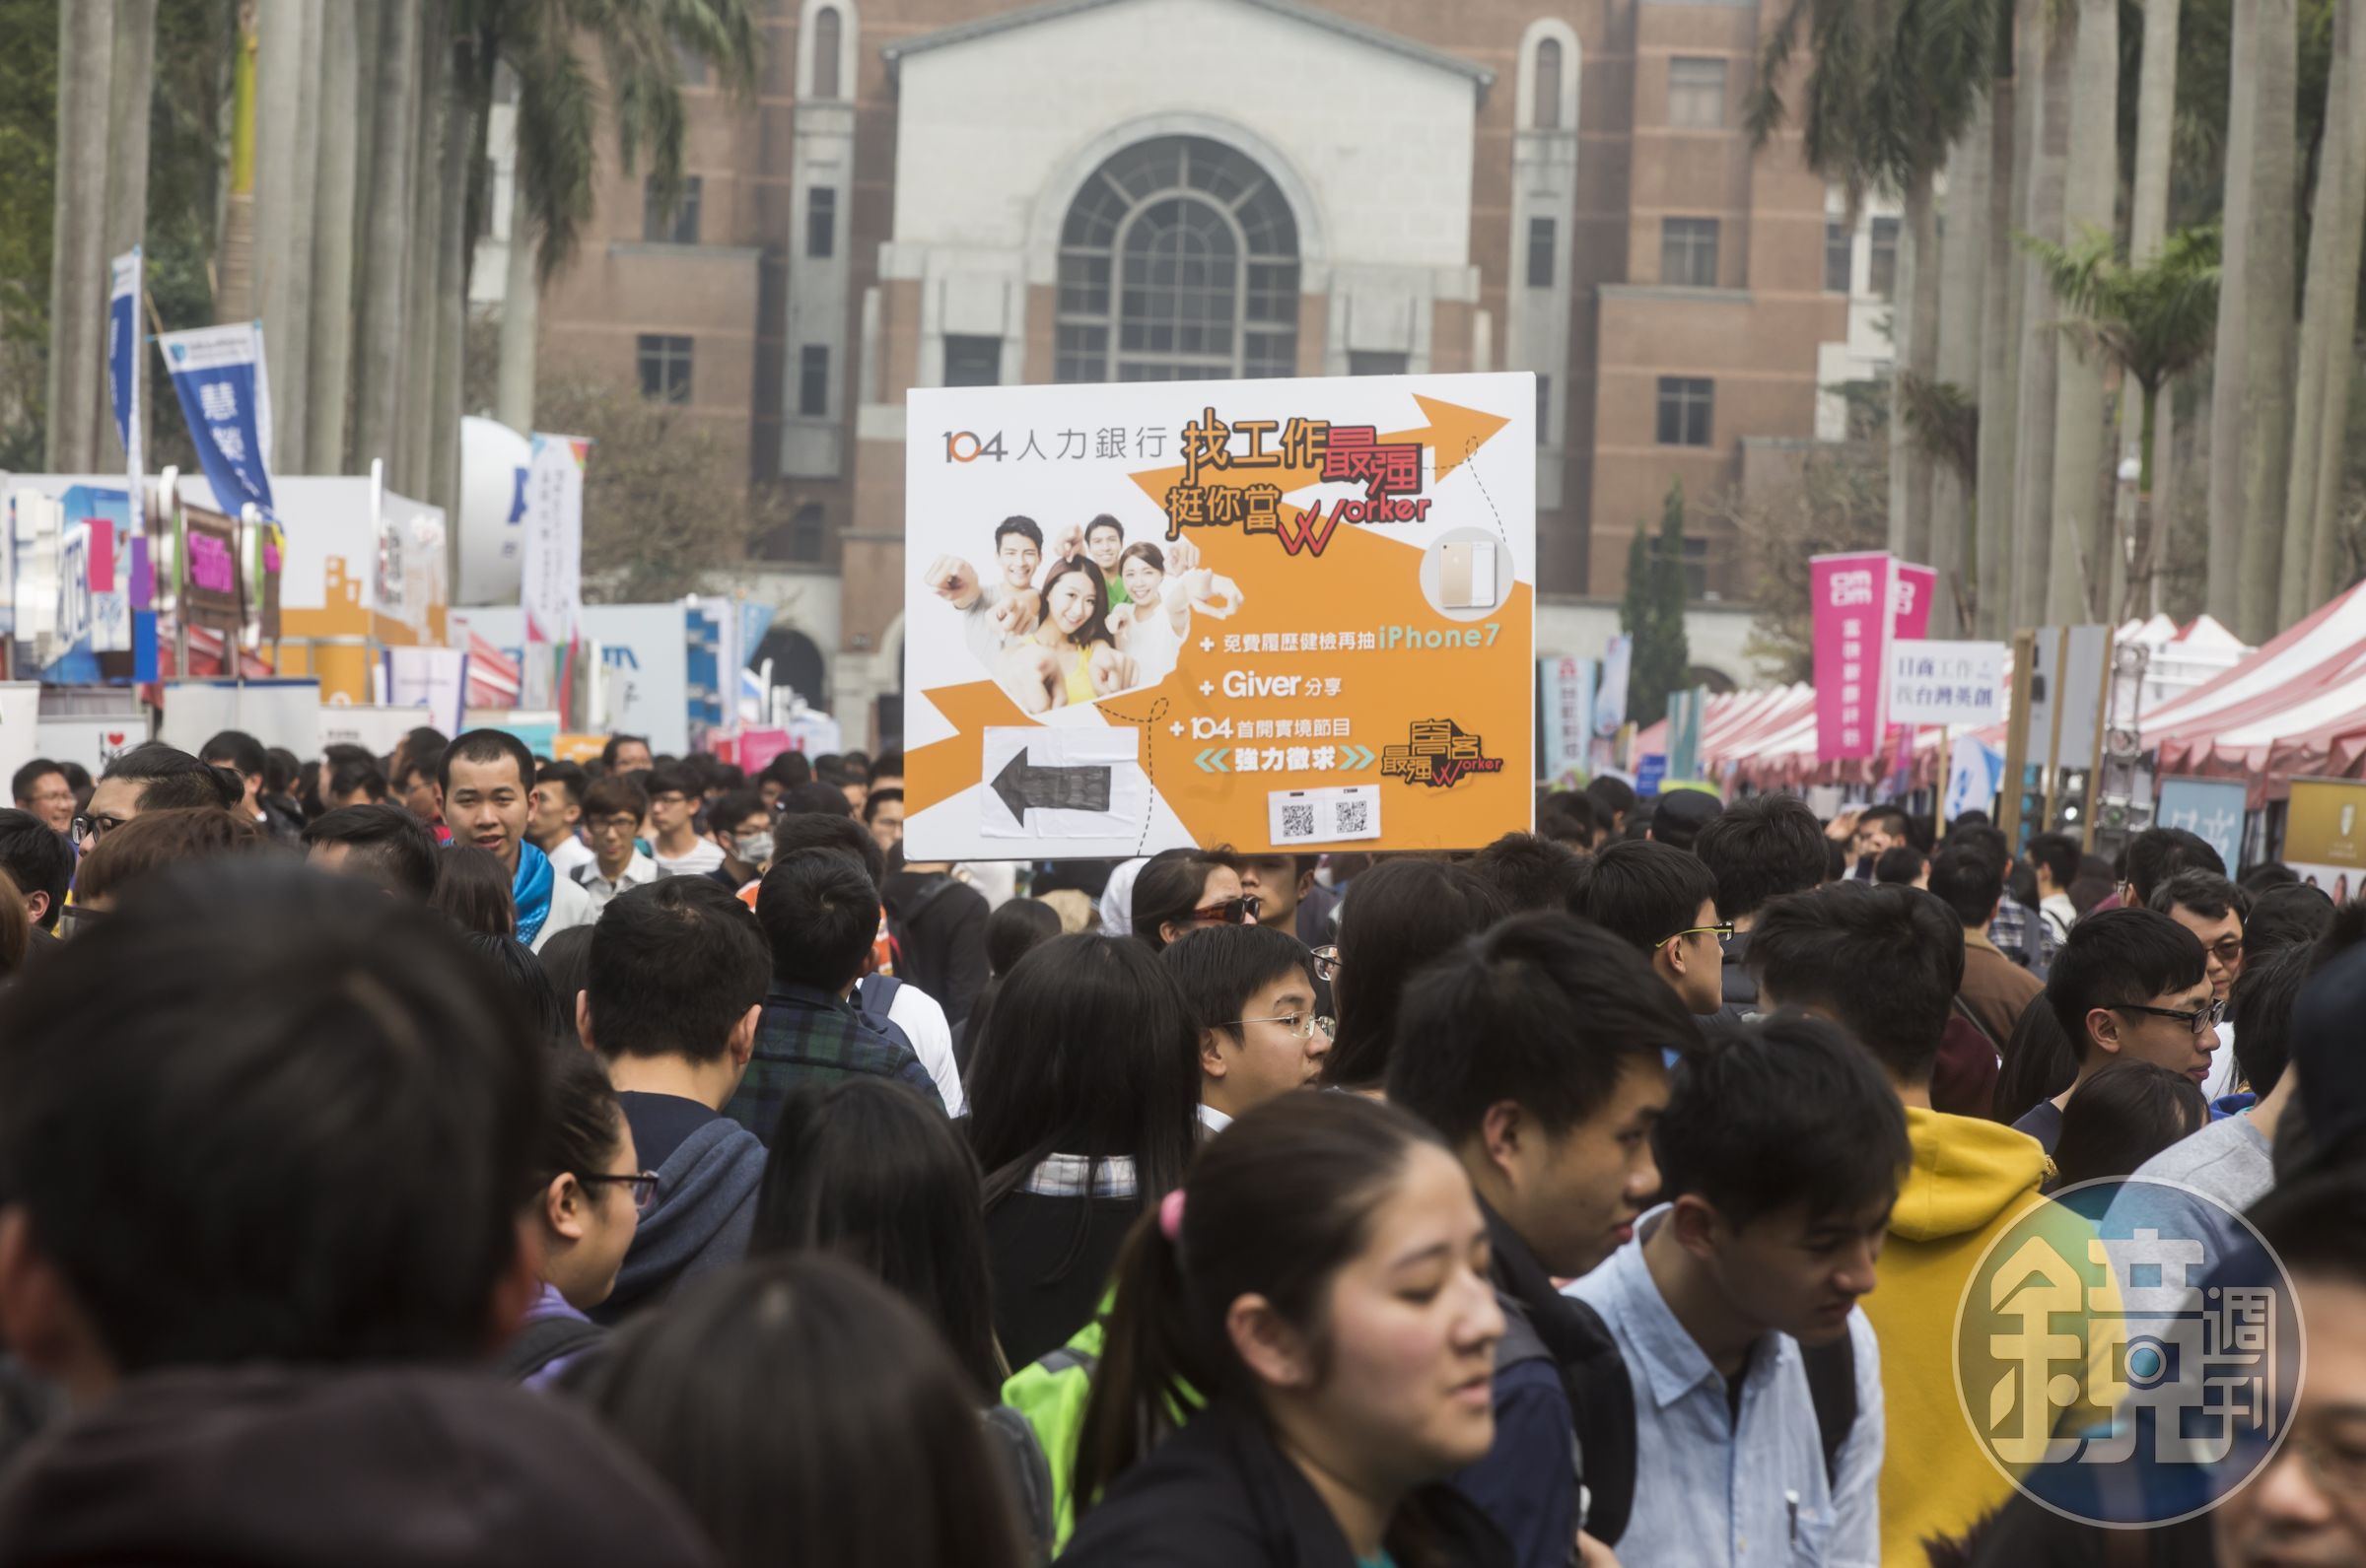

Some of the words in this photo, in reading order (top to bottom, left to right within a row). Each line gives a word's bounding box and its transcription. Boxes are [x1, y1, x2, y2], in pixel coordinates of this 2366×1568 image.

[942, 430, 1009, 463] 104
[1016, 426, 1167, 461] 人力銀行
[1222, 670, 1301, 698] Giver
[1304, 677, 1342, 697] 分享
[1190, 716, 1233, 740] 104
